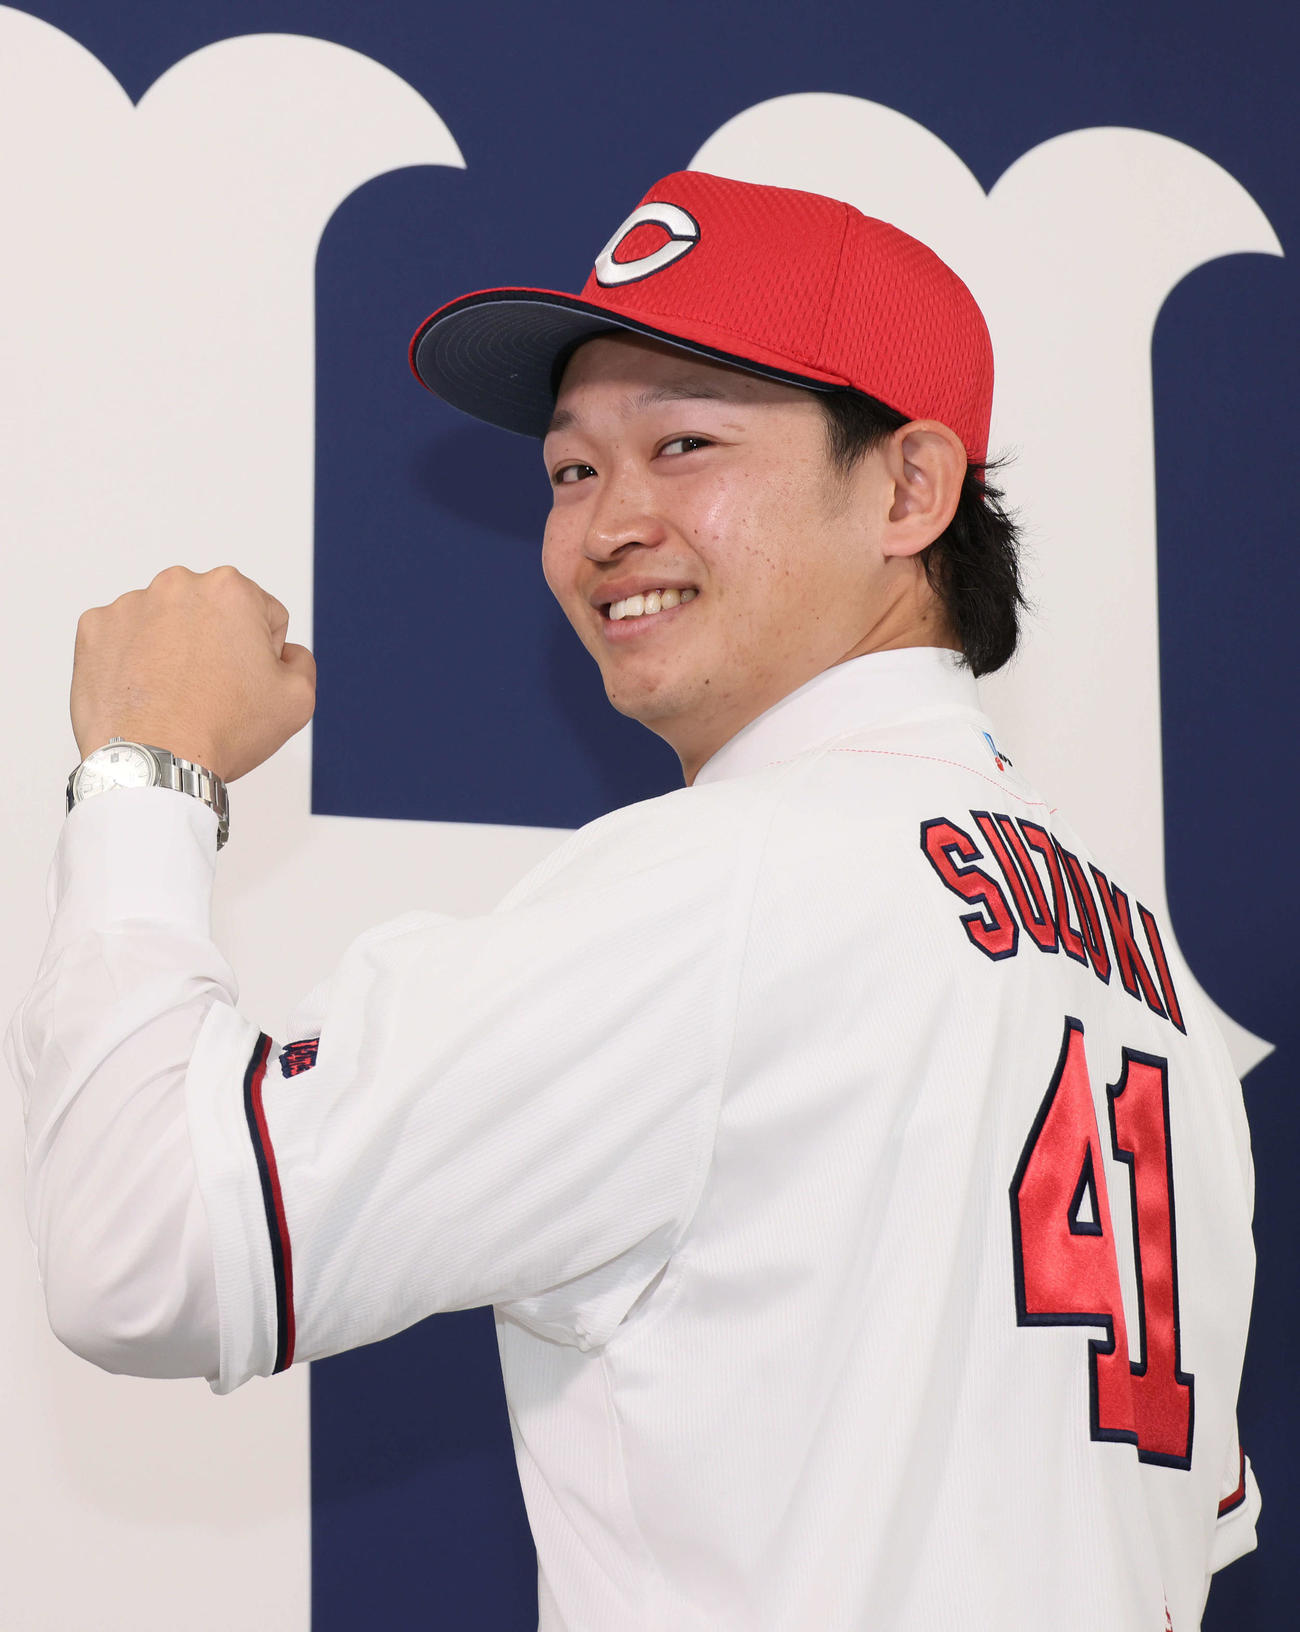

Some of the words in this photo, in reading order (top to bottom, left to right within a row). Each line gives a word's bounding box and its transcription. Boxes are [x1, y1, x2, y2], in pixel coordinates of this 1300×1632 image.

[594, 201, 701, 288] C
[920, 809, 1187, 1036] SUZUKI
[1009, 1014, 1195, 1471] 41
